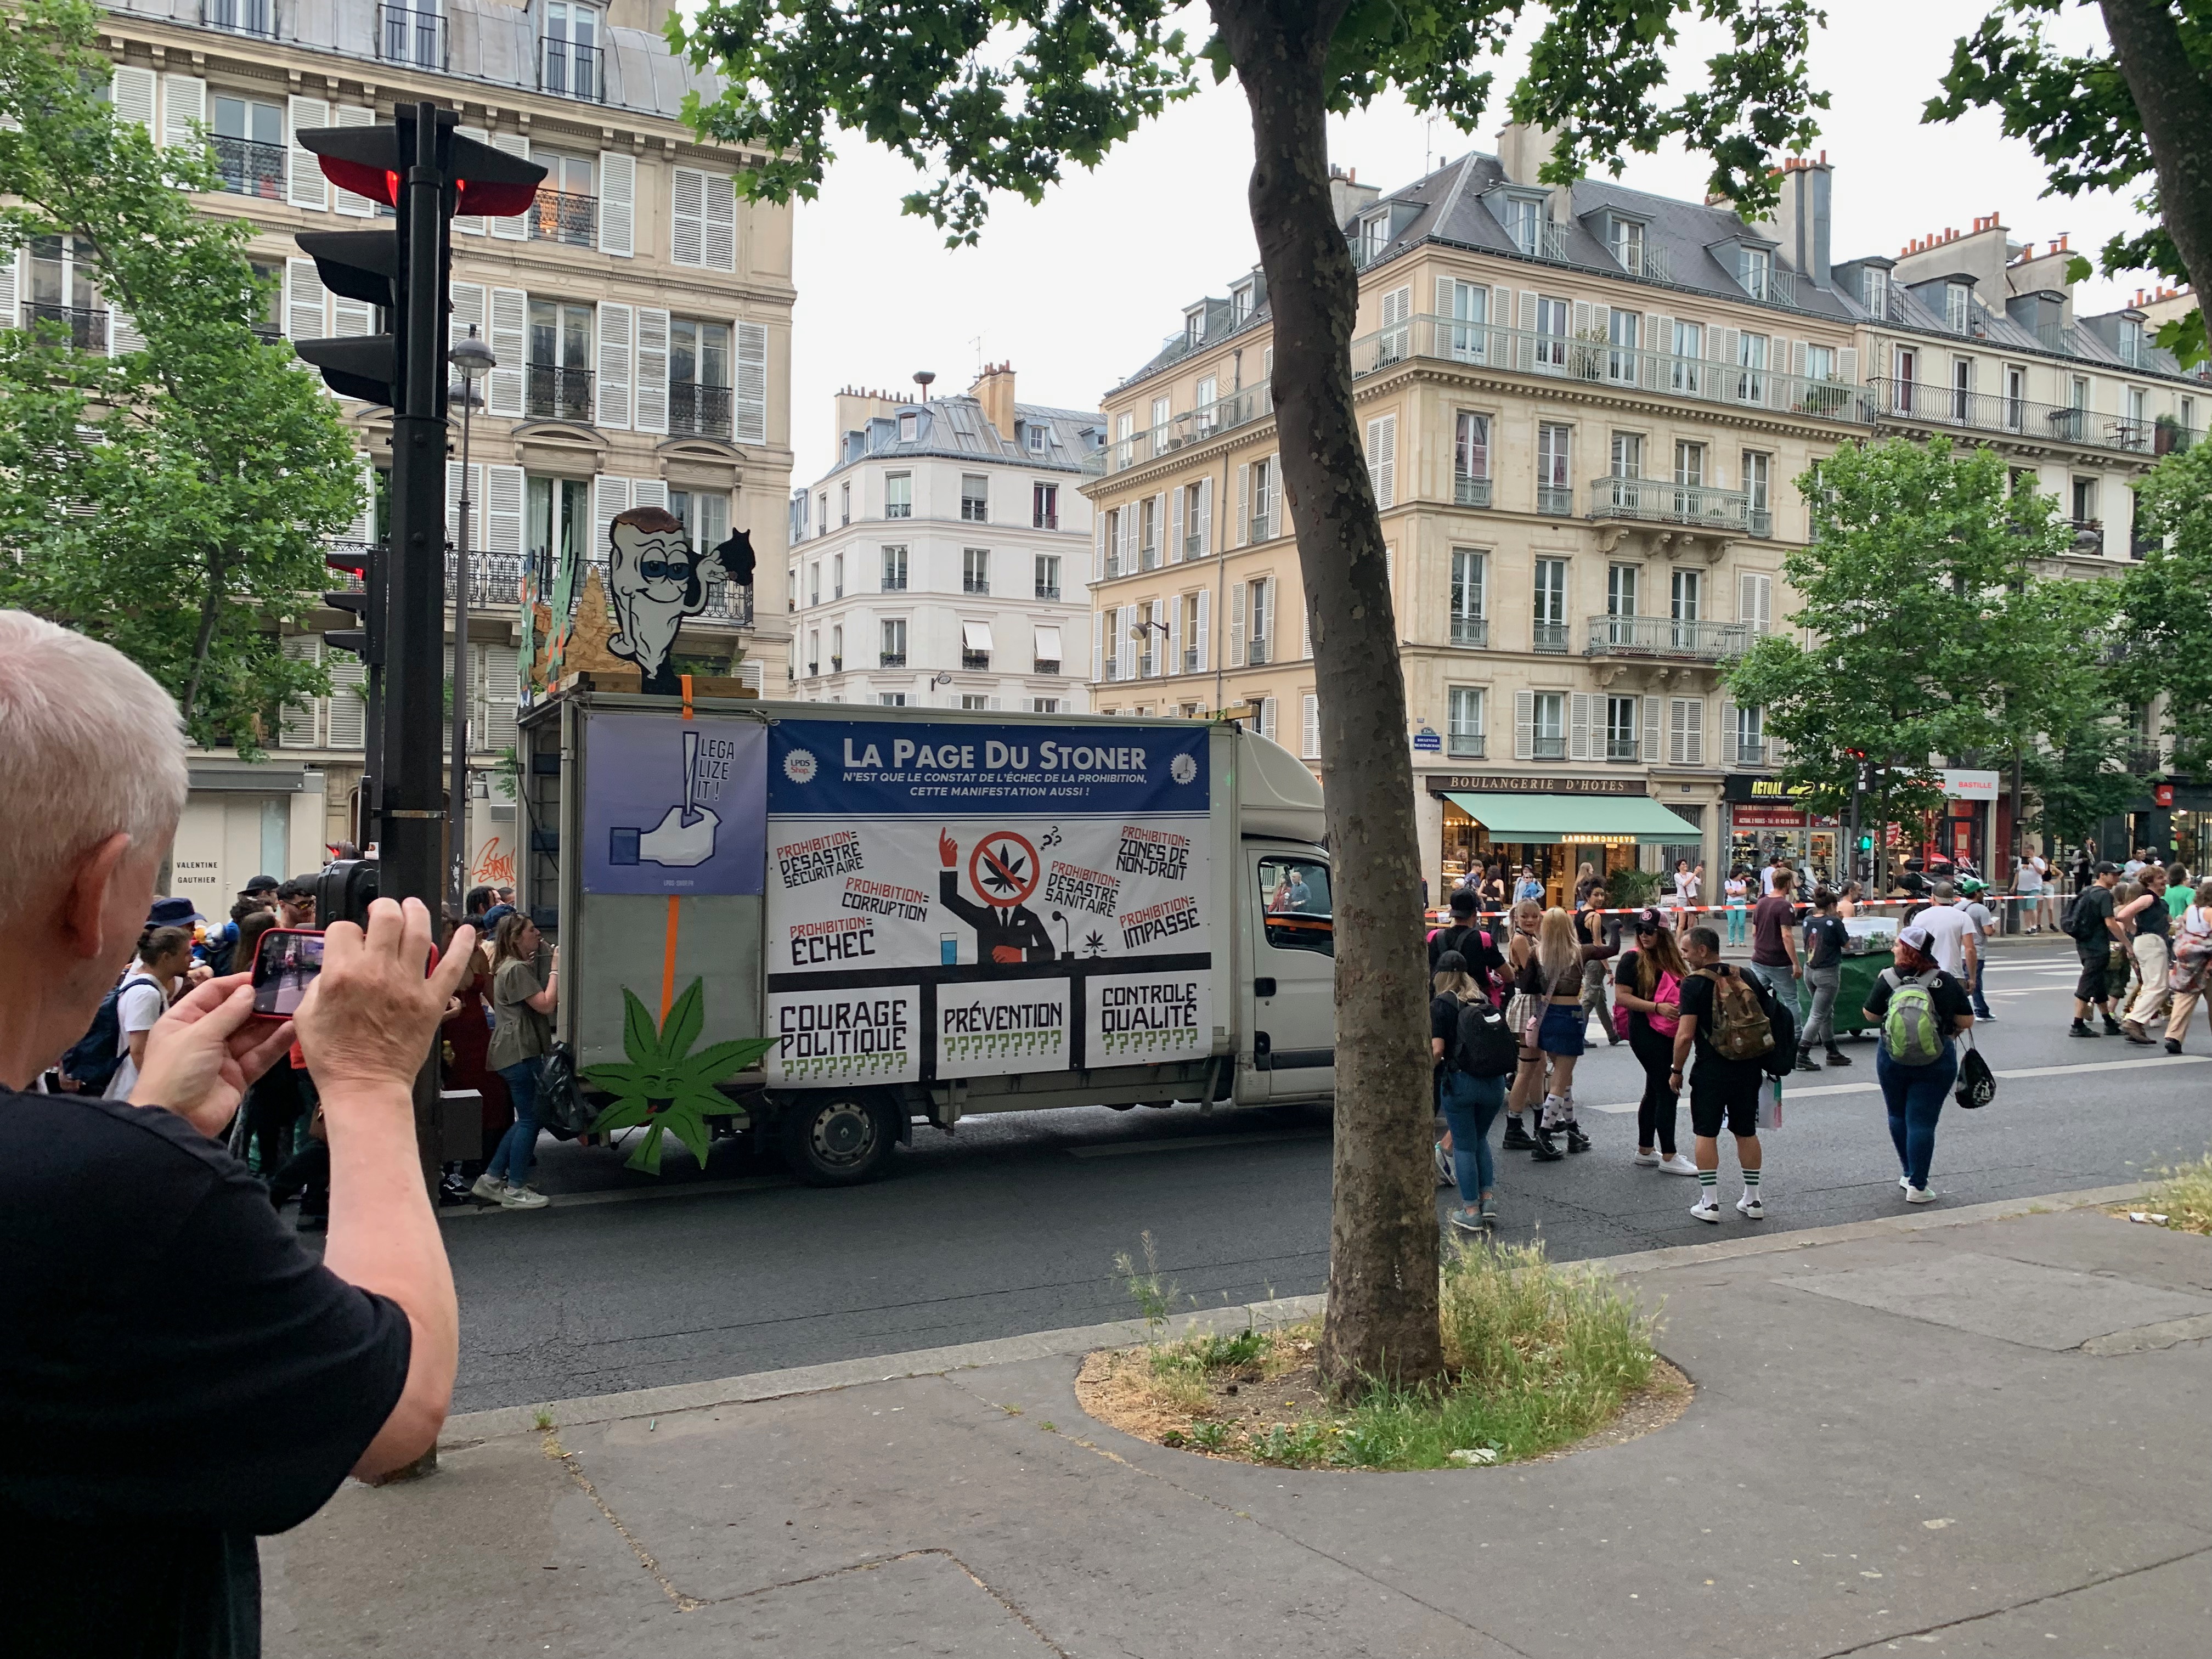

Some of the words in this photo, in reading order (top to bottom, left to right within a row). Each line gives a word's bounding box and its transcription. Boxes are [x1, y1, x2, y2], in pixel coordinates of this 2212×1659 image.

[701, 738, 735, 760] LEGA
[698, 759, 729, 780] LIZE
[843, 772, 877, 782] N'EST
[880, 772, 905, 782] QUE
[907, 773, 922, 782] LE
[924, 773, 977, 782] CONSTAT
[979, 773, 995, 782] DE
[997, 771, 1042, 783] L'ÉCHEC
[1044, 774, 1059, 782] DE
[1061, 774, 1075, 783] LA
[1077, 774, 1147, 784] PROHIBITION,
[1450, 777, 1554, 789] BOULANGERIE
[696, 780, 710, 799] IT
[910, 787, 949, 796] CETTE
[951, 787, 1047, 797] MANIFESTATION
[1049, 787, 1084, 796] AUSSI
[1751, 781, 1782, 795] ACTUAL
[780, 841, 862, 876] DÉSASTRE
[1118, 838, 1165, 862] ZONES
[1169, 847, 1189, 866] DE
[1116, 855, 1187, 881] NON-DROIT
[1045, 888, 1116, 918] SANITAIRE
[1048, 873, 1119, 904] DÉSASTRE
[842, 891, 927, 922] CORRUPTION
[1123, 907, 1200, 949] IMPASSE
[791, 929, 876, 966] ÉCHEC
[1102, 983, 1197, 1007] CONTROLE
[780, 1000, 907, 1033] COURAGE
[944, 1001, 1062, 1034] PRÉVENTION
[1102, 998, 1198, 1035] QUALITÉ
[781, 1026, 907, 1059] POLITIQUE
